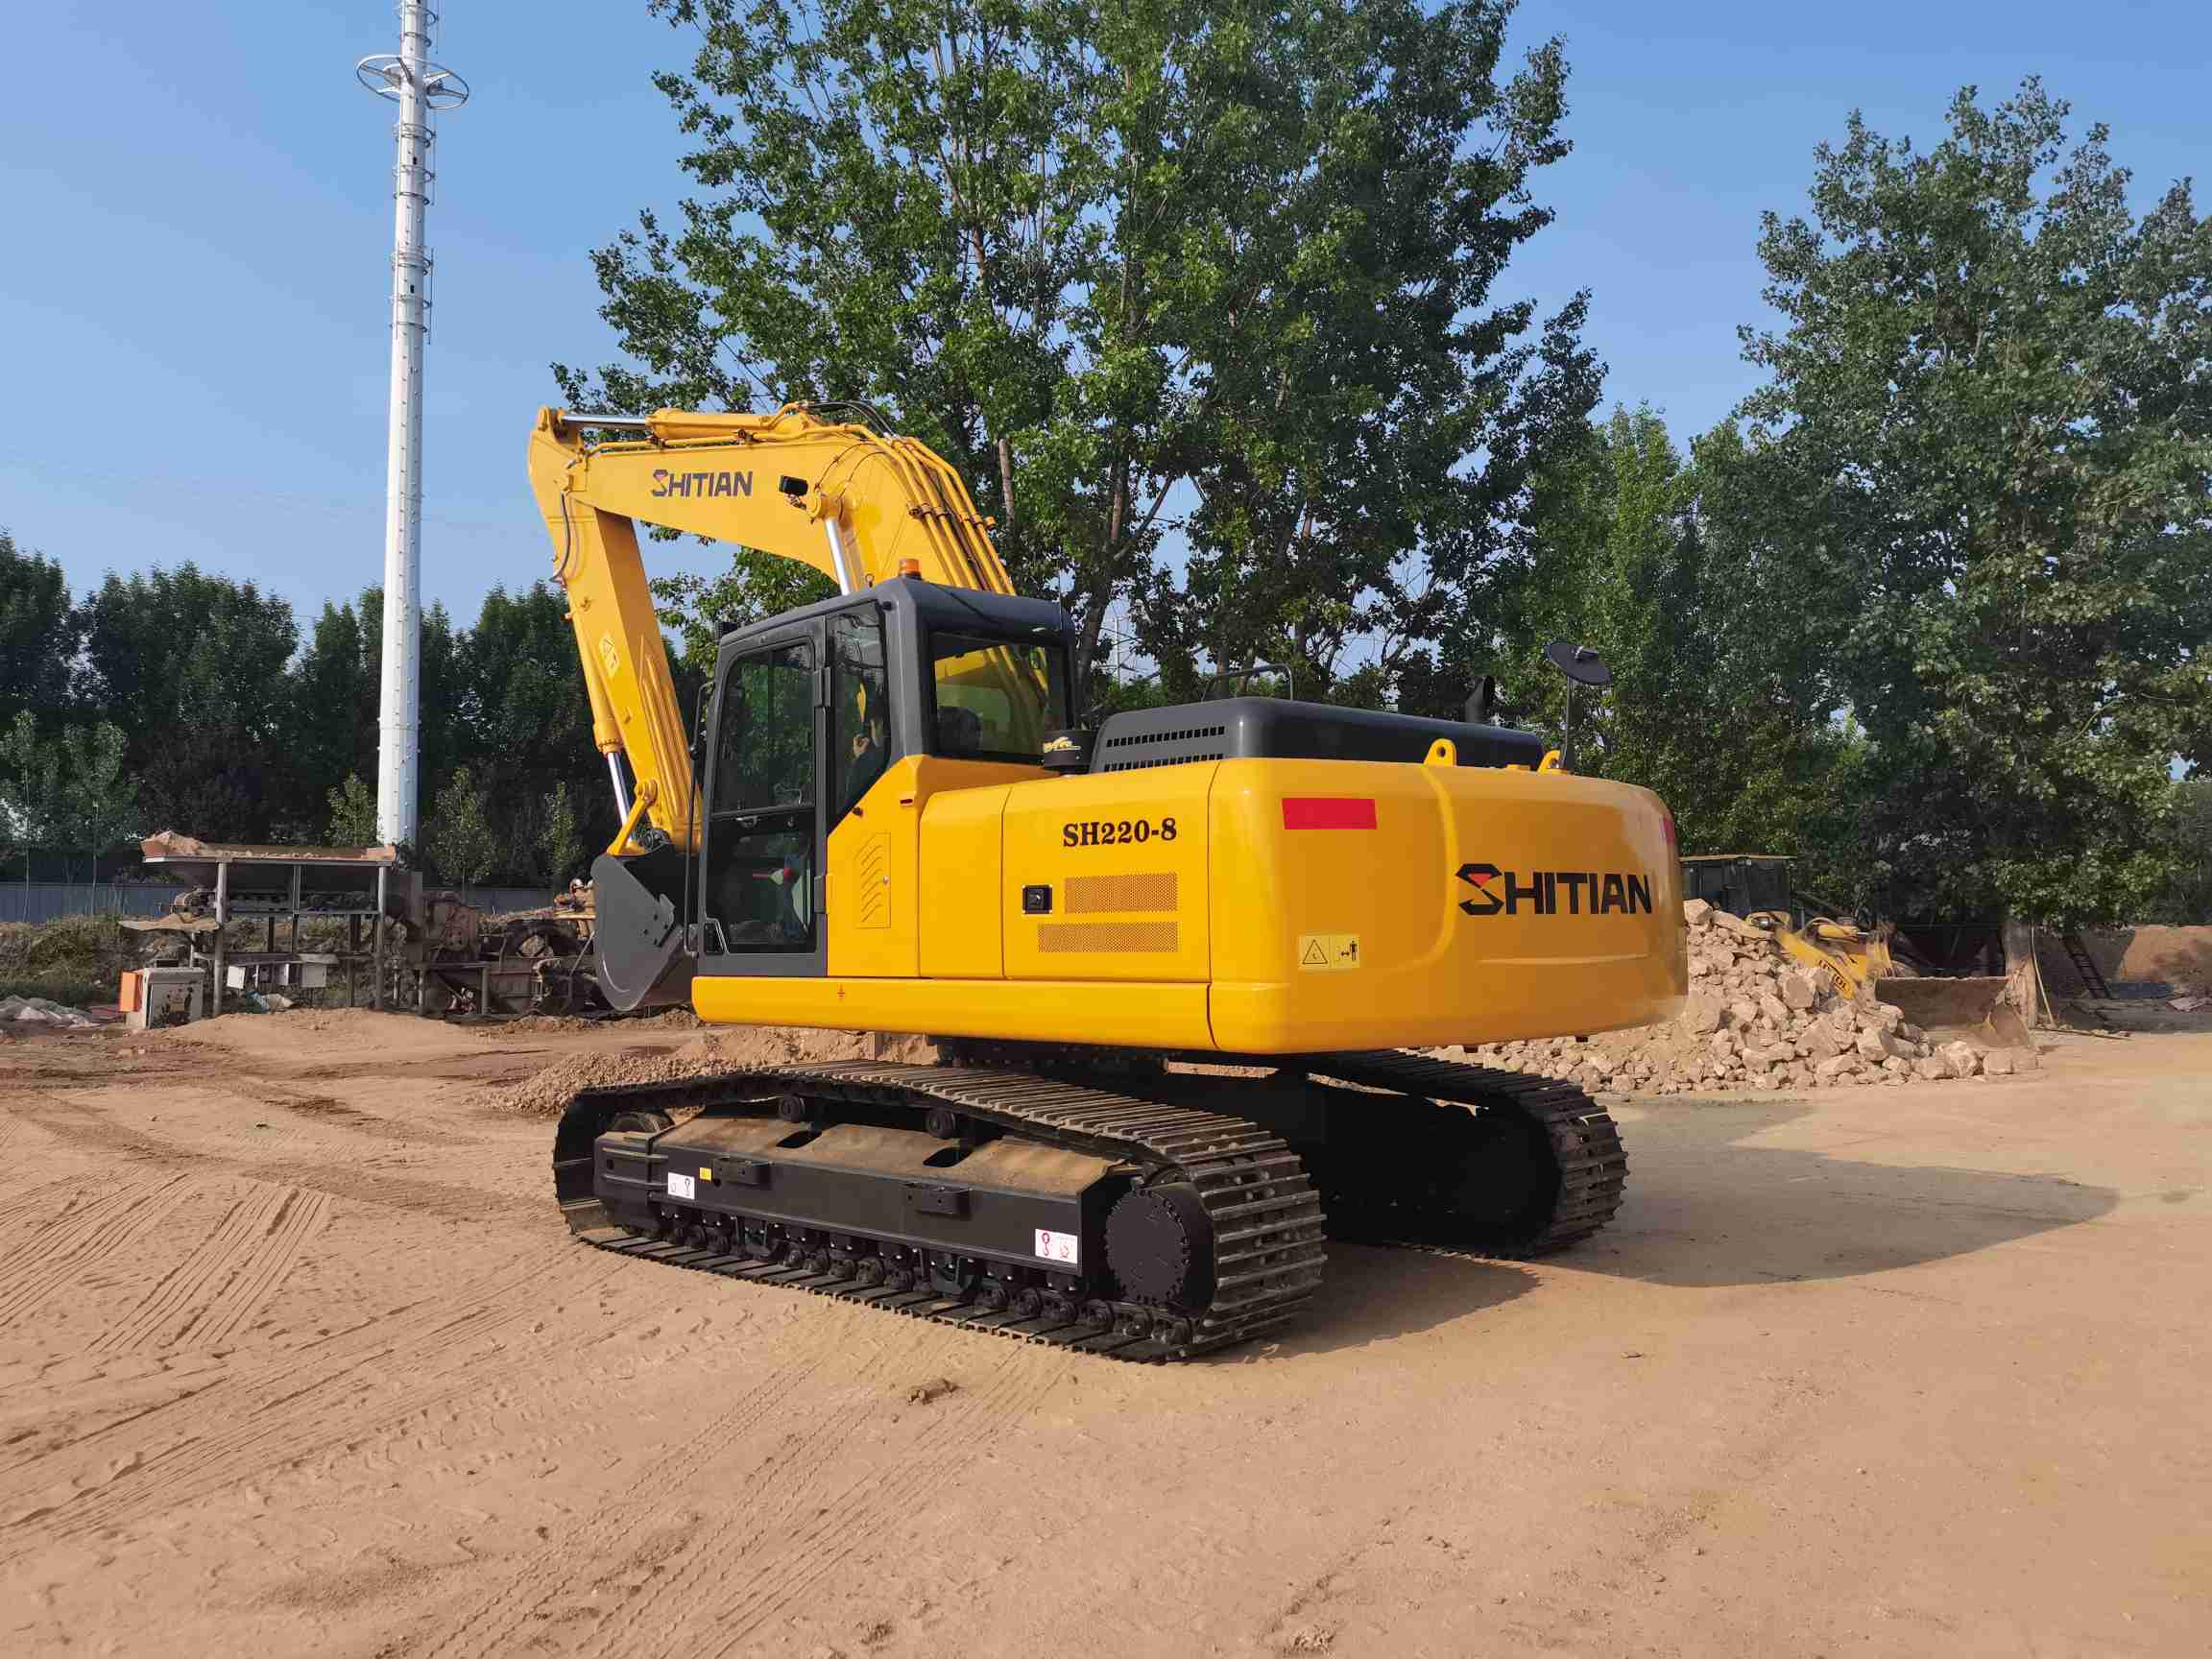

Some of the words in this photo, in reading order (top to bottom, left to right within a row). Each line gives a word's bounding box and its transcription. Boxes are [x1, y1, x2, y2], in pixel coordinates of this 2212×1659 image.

[651, 469, 753, 497] SHITIAN
[1063, 817, 1177, 847] SH220-8
[1455, 863, 1652, 916] SHITIAN
